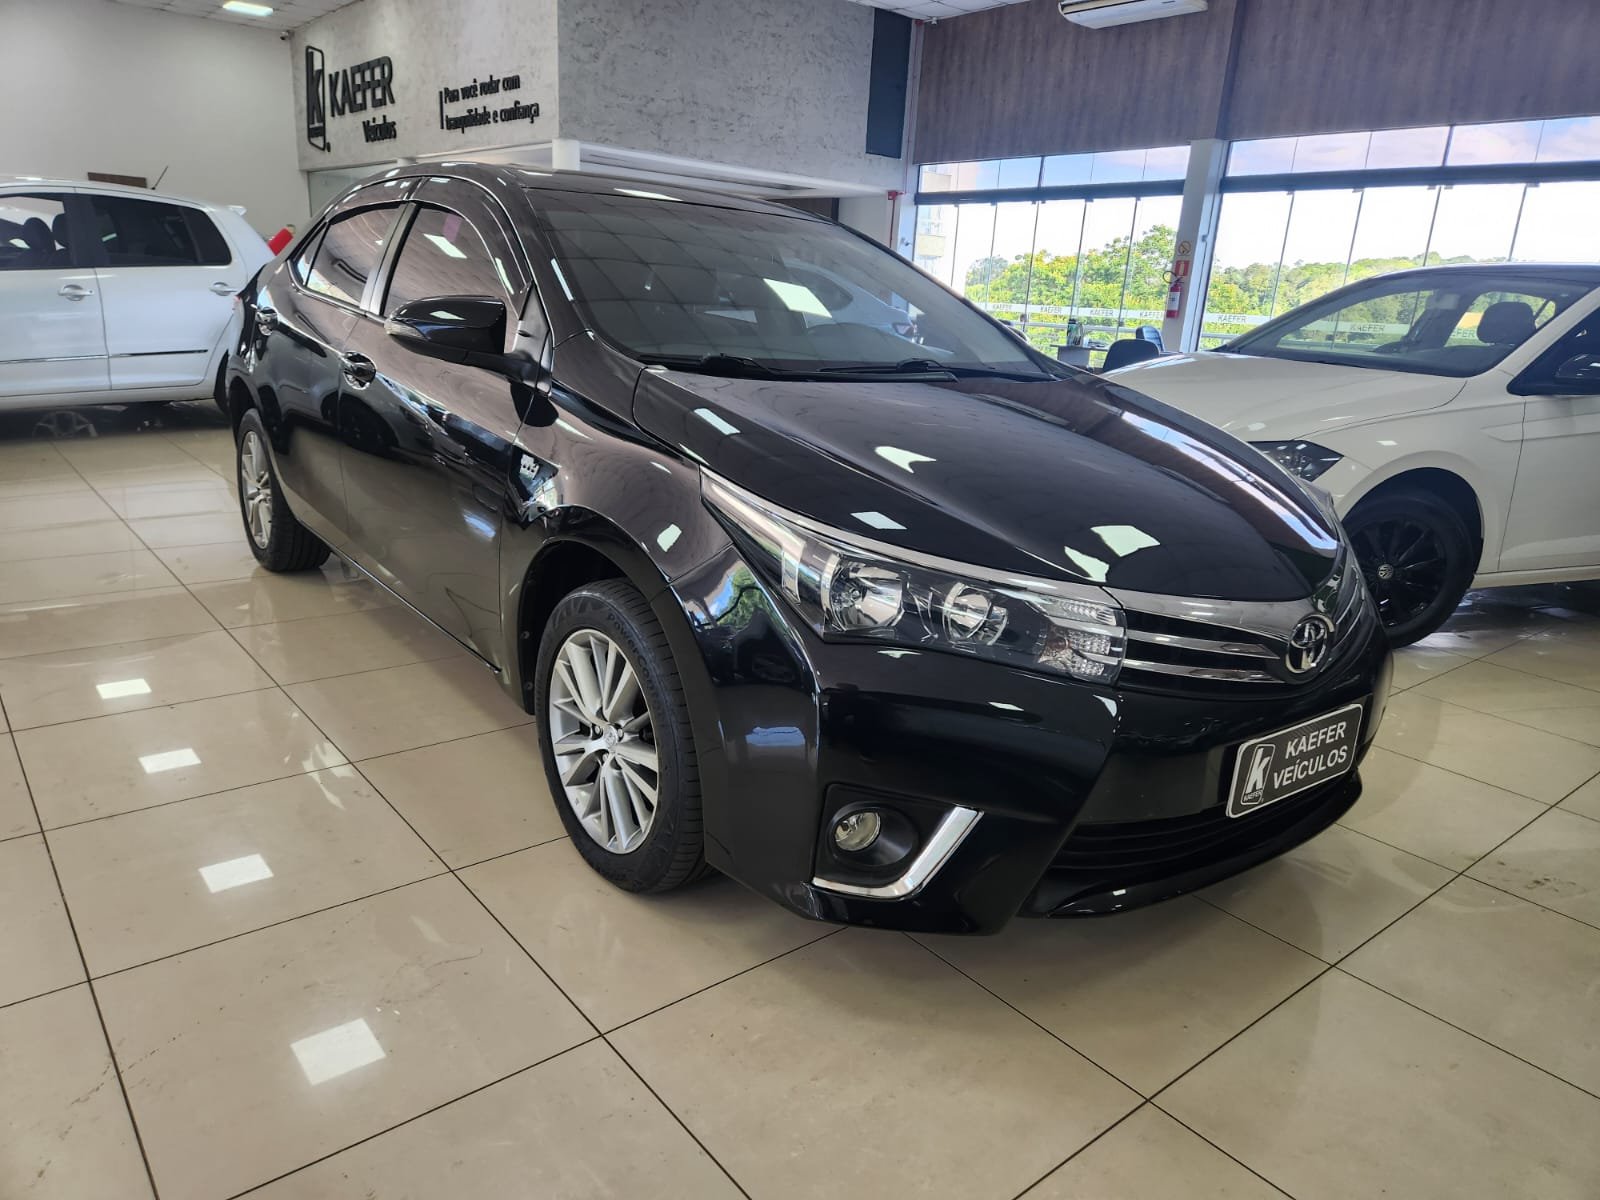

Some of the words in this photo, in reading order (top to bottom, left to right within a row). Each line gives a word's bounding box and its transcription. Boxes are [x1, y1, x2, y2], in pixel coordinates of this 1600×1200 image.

[328, 56, 395, 117] KAEFER
[444, 87, 460, 104] Para
[460, 78, 478, 100] você
[479, 75, 500, 96] rodar
[502, 75, 520, 91] com
[492, 110, 498, 123] e
[500, 100, 540, 124] confiança
[362, 114, 397, 143] Veículos
[1218, 315, 1247, 323] KAEFER
[1350, 323, 1385, 333] KAEFER
[1285, 721, 1347, 759] KAEFER
[1273, 745, 1348, 789] VEÍCULOS
